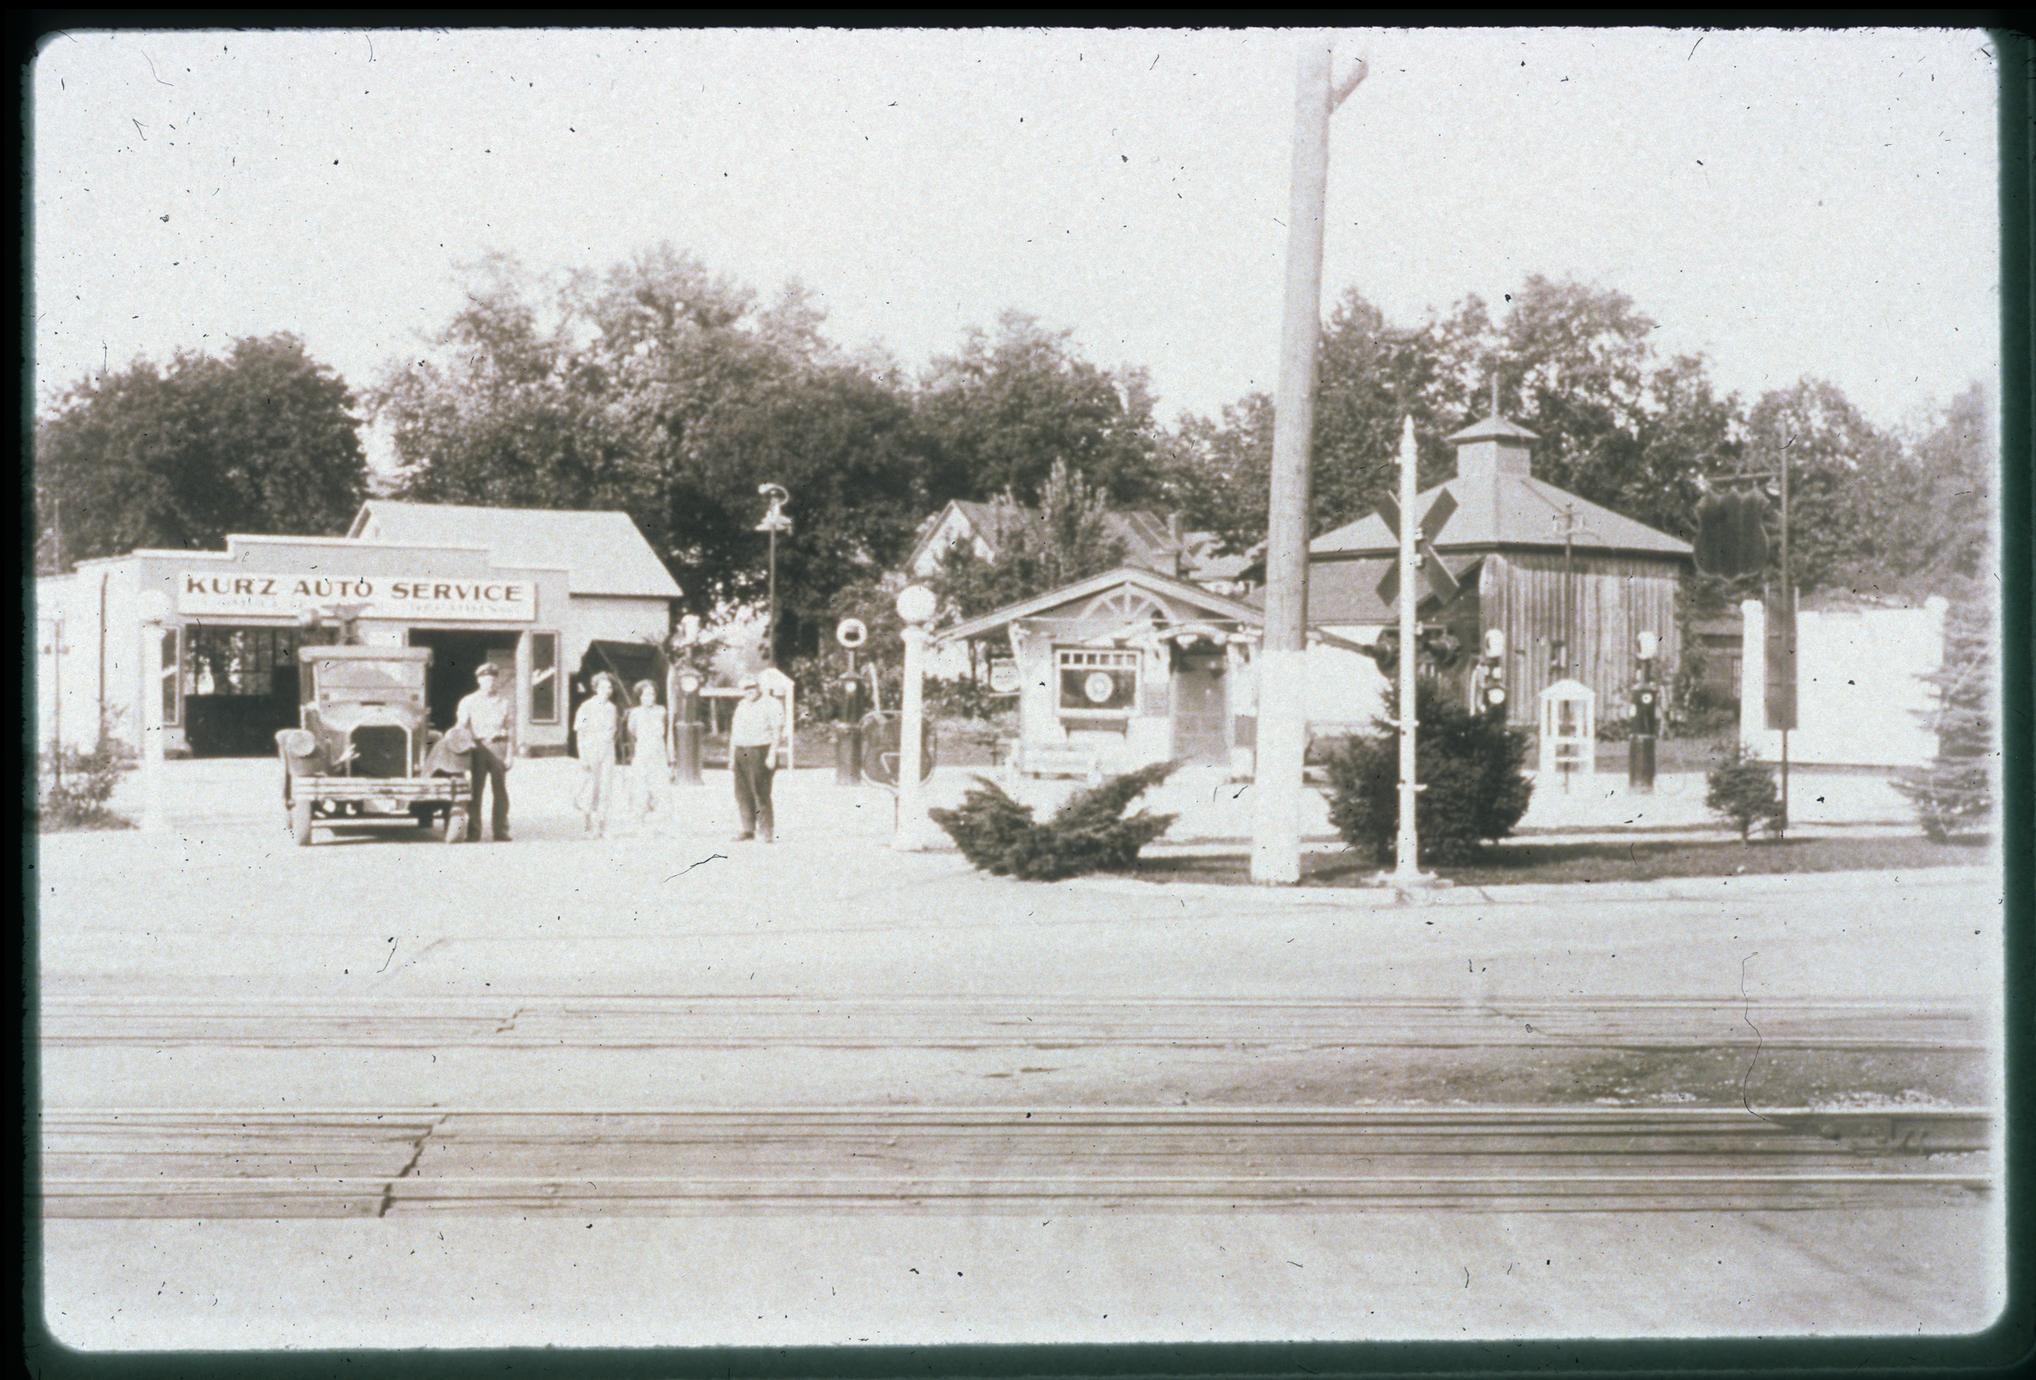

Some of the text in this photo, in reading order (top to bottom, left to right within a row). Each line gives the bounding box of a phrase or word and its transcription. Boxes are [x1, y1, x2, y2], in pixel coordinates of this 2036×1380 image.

[187, 577, 523, 602] KURZ AUTO SERVICE
